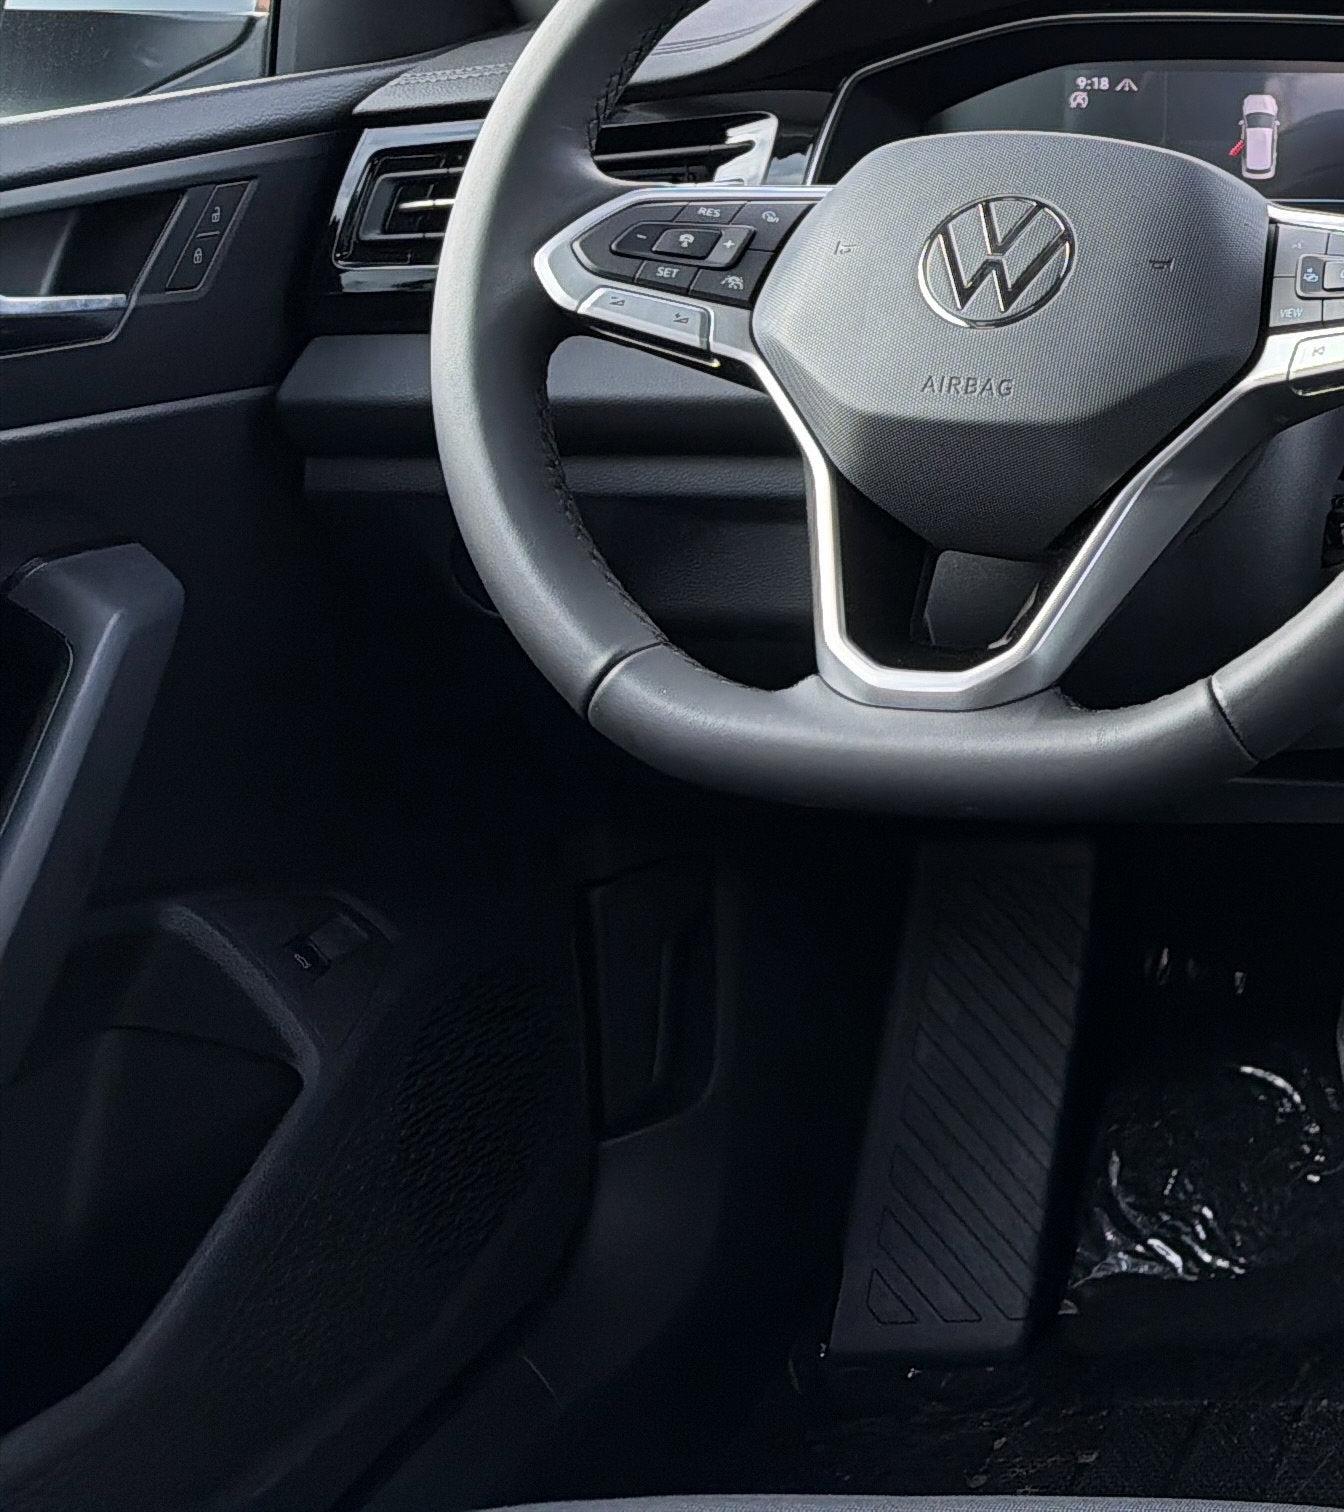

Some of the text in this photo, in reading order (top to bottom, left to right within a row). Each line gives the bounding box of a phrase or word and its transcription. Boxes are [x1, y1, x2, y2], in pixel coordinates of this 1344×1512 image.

[1075, 76, 1110, 90] 9:18
[698, 207, 721, 218] RES
[655, 267, 680, 279] SET
[1280, 308, 1304, 318] VIEW
[920, 374, 1014, 397] AIRBAG
